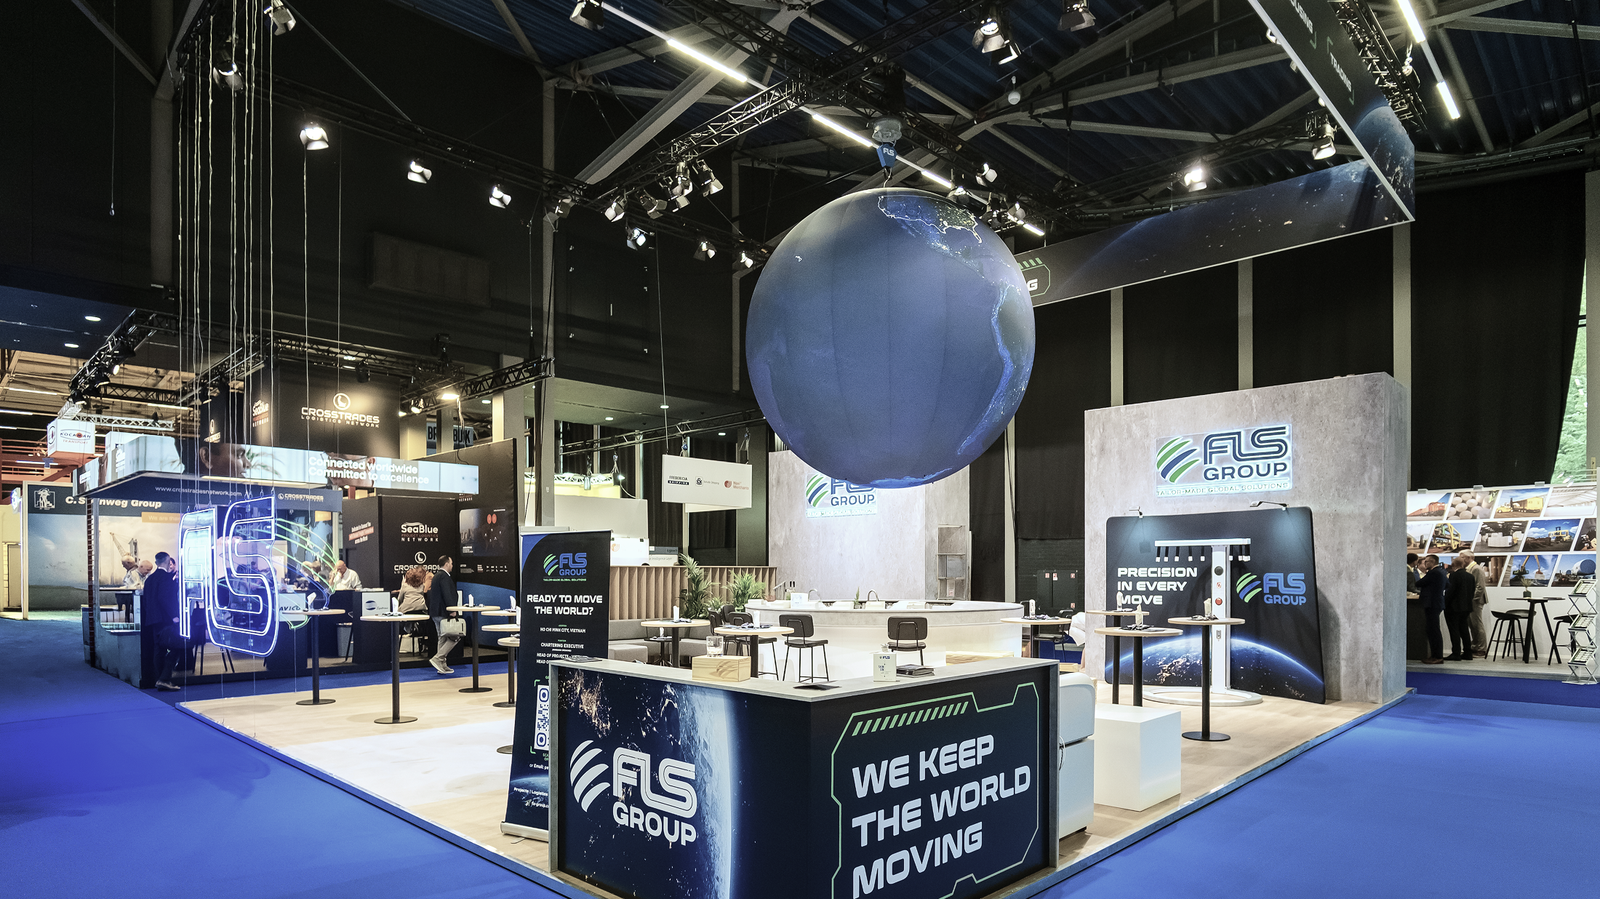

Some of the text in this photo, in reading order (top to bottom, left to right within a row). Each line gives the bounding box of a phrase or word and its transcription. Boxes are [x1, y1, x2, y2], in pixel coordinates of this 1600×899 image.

[301, 407, 380, 424] CROSSTRADES
[301, 415, 380, 429] LOGISTICS NETWORK
[1204, 426, 1288, 465] FLS
[308, 456, 418, 475] Connected worldwide
[1203, 462, 1288, 481] GROUP
[308, 467, 430, 485] Committed to excellence
[1241, 482, 1289, 491] SOLUTIONS
[65, 496, 76, 504] C.
[130, 498, 162, 509] Group
[831, 494, 875, 506] GROUP
[401, 524, 439, 534] SeaBlue
[559, 553, 587, 568] FLS
[1117, 567, 1198, 578] PRECISION
[1117, 581, 1188, 592] IN EVERY
[1263, 573, 1306, 595] FLS
[527, 594, 603, 604] READY TO MOVE
[1121, 595, 1163, 605] MOVE
[1264, 595, 1307, 606] GROUP
[534, 606, 594, 616] THE WORLD?
[852, 734, 994, 799] WE KEEP
[613, 747, 698, 818] FLS
[851, 765, 1031, 847] THE WORLD
[612, 801, 697, 846] GROUP
[852, 821, 983, 899] MOVING
